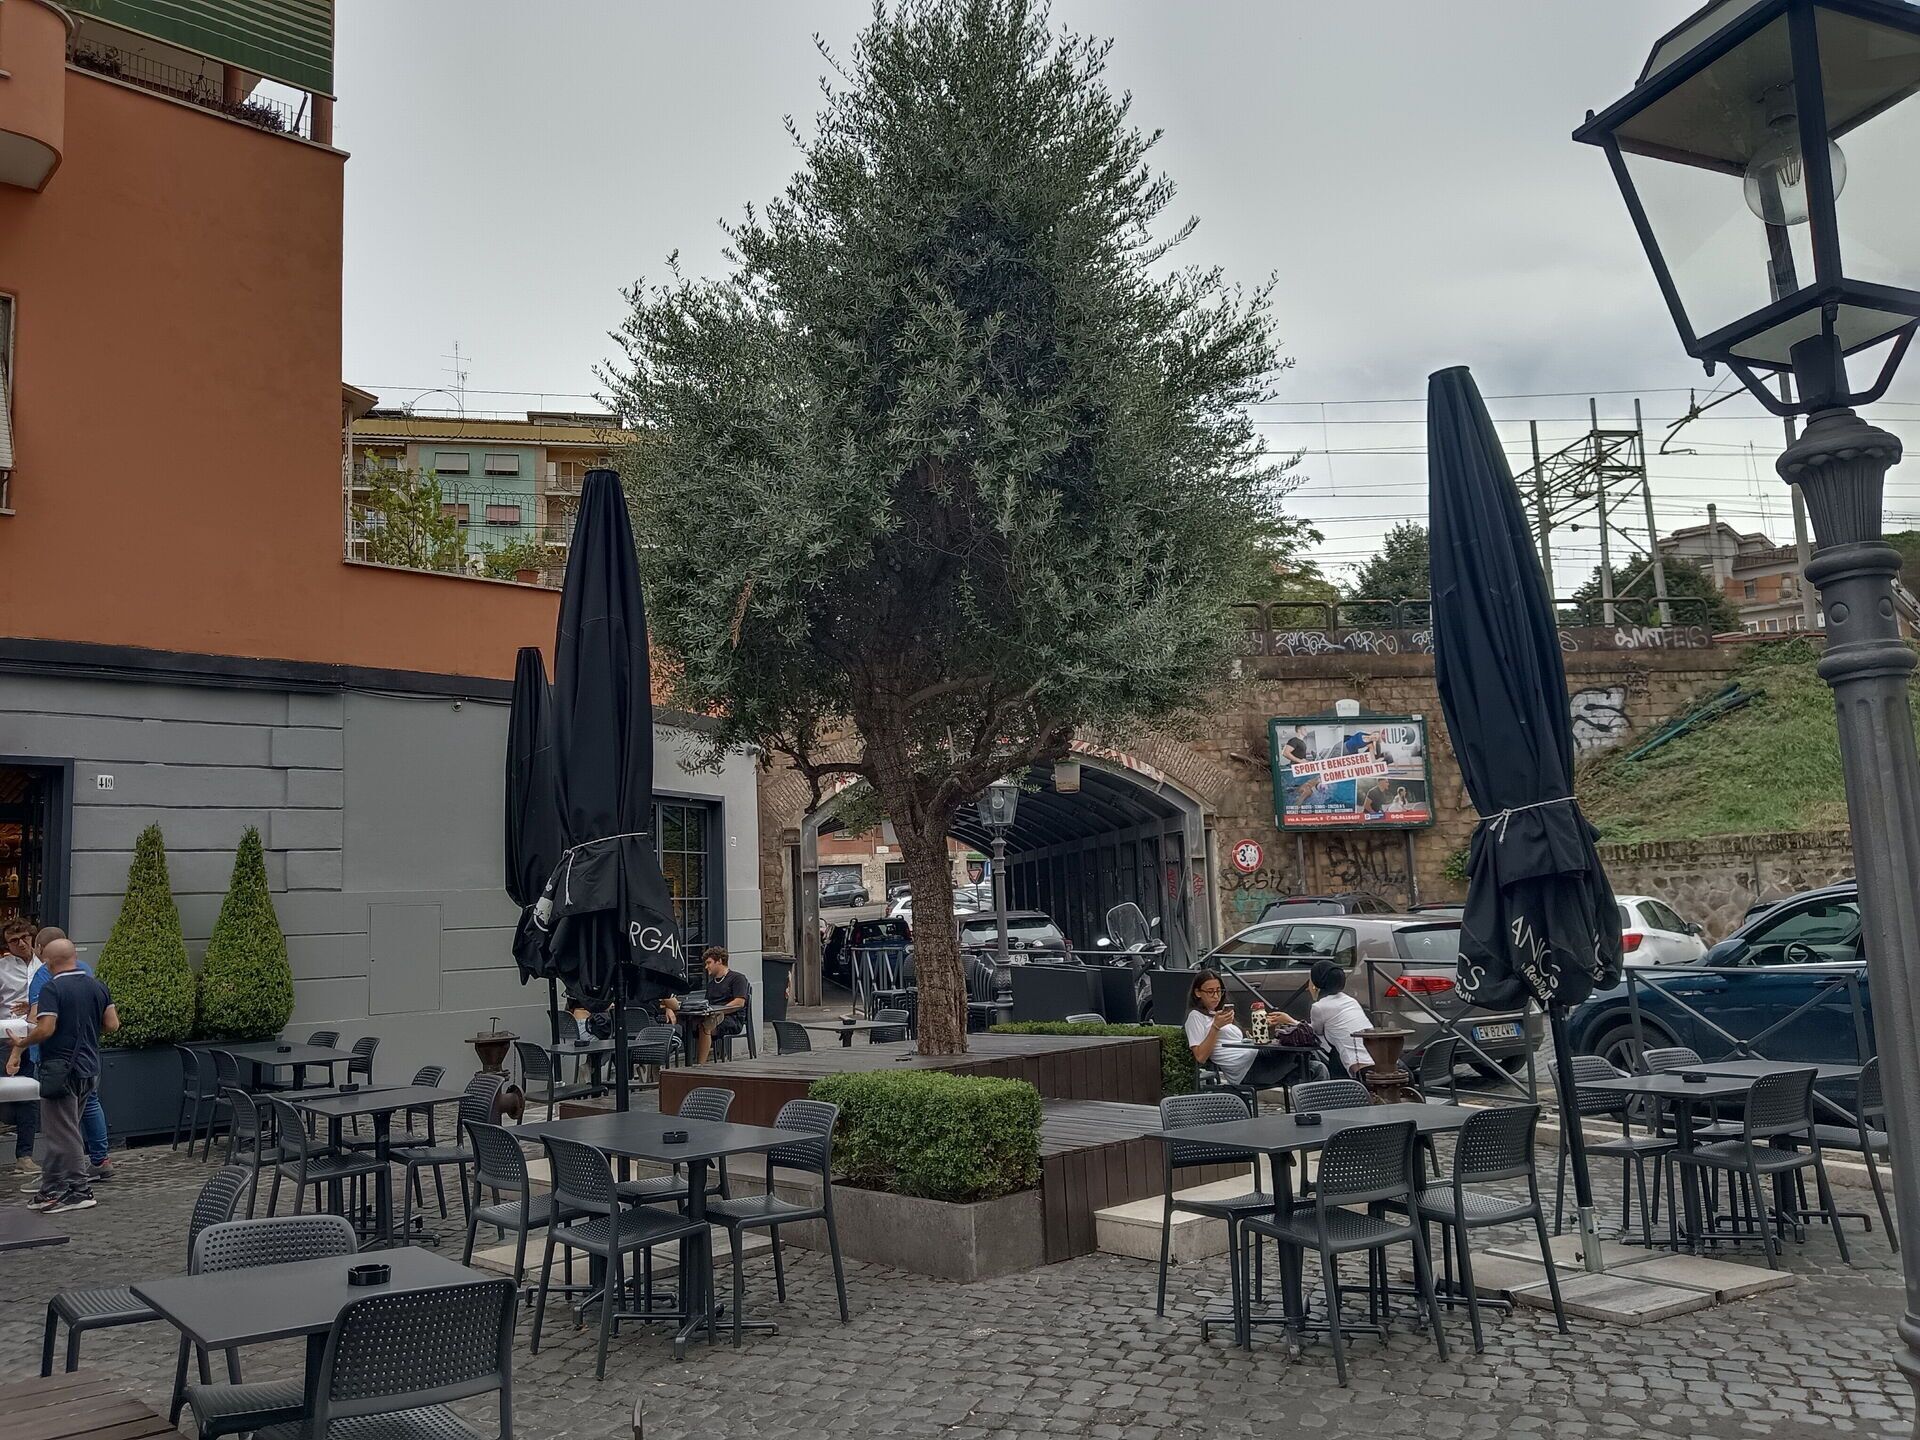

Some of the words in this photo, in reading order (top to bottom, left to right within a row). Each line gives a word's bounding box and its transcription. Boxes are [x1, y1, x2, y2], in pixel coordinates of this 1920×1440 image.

[1294, 762, 1320, 775] SPORT
[1327, 754, 1370, 770] BENESSERE
[1323, 770, 1345, 782] COME
[1347, 768, 1354, 778] LI
[1355, 766, 1374, 777] VUOI
[1376, 763, 1386, 773] TU
[98, 776, 113, 789] 419
